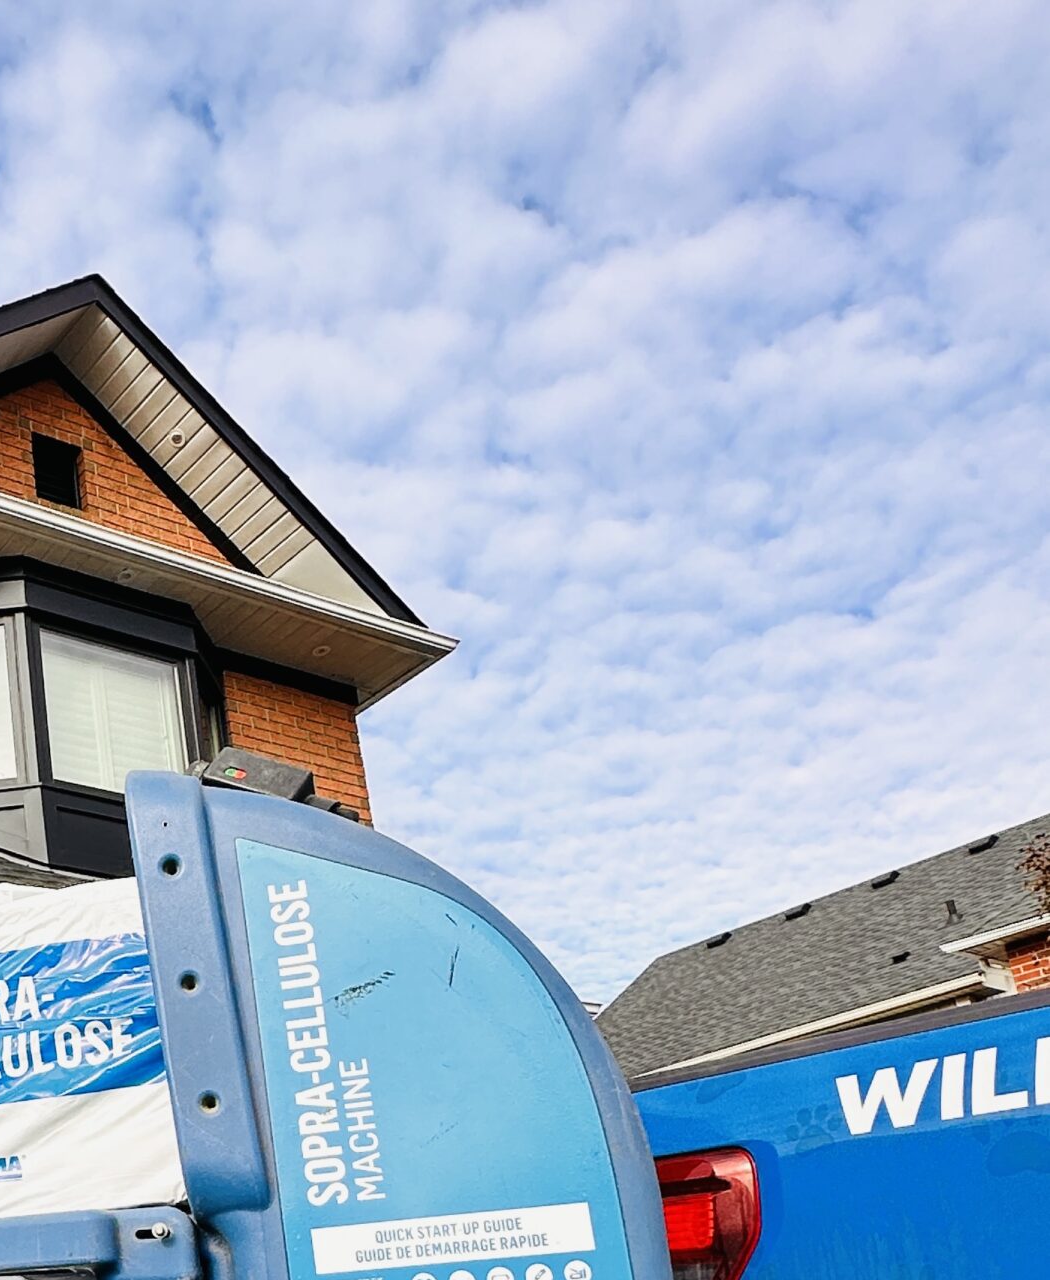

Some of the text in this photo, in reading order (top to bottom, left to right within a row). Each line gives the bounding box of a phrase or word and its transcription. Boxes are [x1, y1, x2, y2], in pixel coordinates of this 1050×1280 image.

[267, 879, 350, 1206] SOPRA-CELLULOSE
[835, 1036, 1050, 1136] WIL
[338, 1058, 386, 1201] MACHINE
[355, 1247, 393, 1263] GUIDE
[396, 1245, 412, 1259] DE
[500, 1233, 549, 1250] RAPIDE
[375, 1227, 414, 1244] QUICK
[483, 1217, 523, 1233] GUIDE
